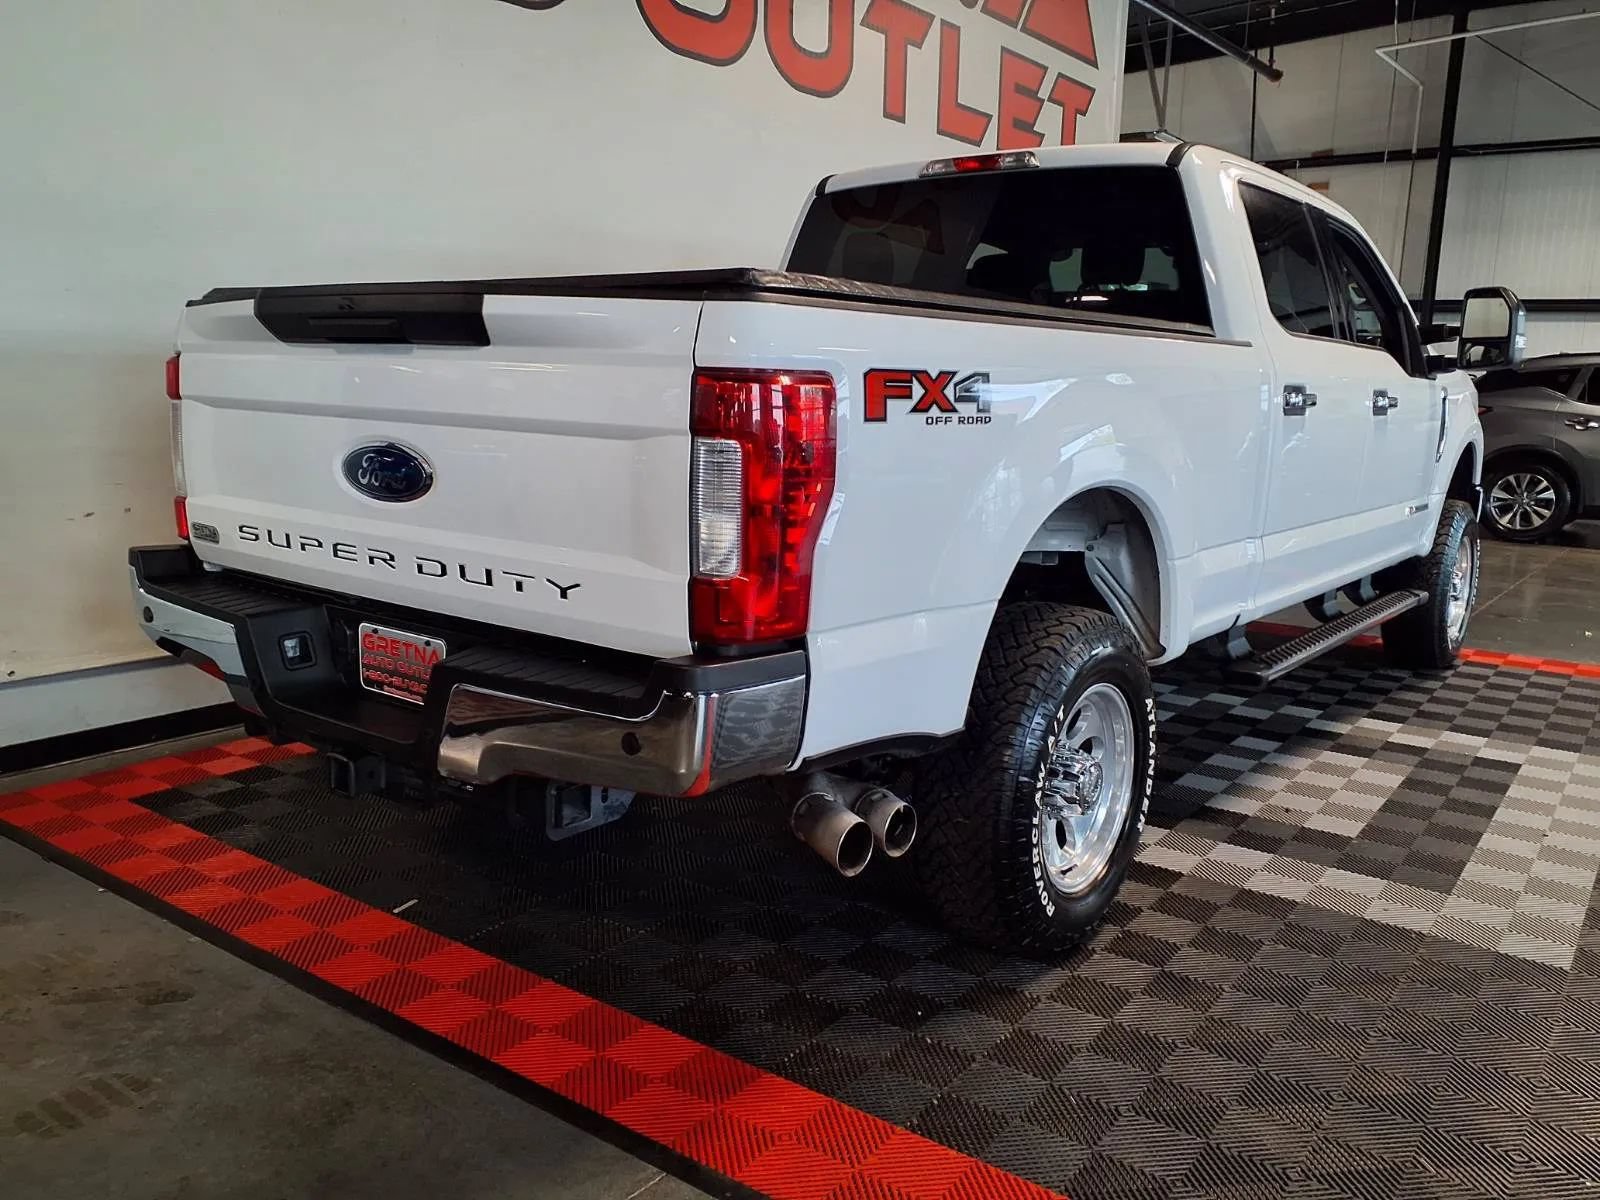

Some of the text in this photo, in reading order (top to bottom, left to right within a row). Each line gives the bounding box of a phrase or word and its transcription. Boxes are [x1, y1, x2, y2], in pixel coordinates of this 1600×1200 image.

[864, 368, 990, 422] FX4
[926, 416, 992, 425] OFF ROAD
[238, 524, 396, 569] SUPER
[415, 556, 581, 600] DUTY
[363, 631, 440, 666] GRETNA
[1137, 698, 1156, 833] ATLANDER
[1031, 761, 1055, 917] ROVERCLAW
